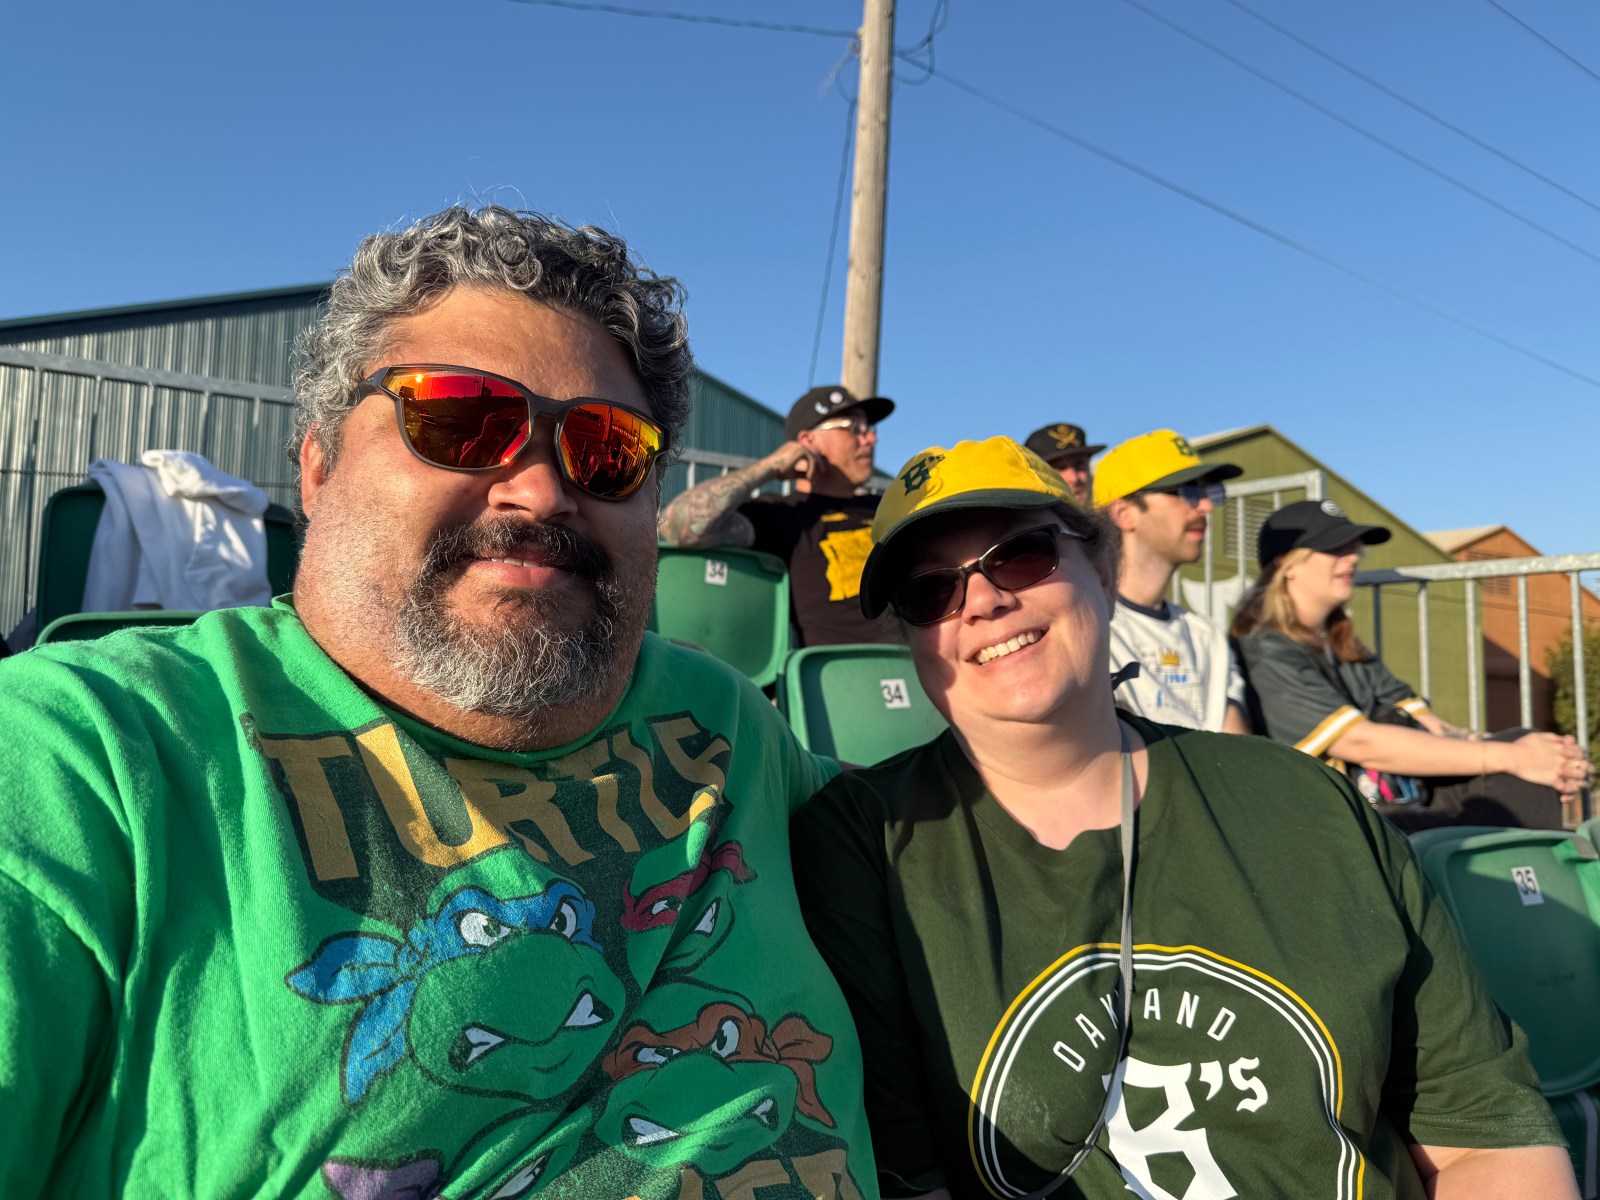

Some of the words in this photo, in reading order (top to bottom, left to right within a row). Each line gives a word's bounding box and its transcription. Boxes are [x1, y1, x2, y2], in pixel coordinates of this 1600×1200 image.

[709, 560, 726, 578] 34
[882, 683, 904, 704] 34
[1515, 869, 1538, 896] 35
[1053, 988, 1236, 1072] OAKAND
